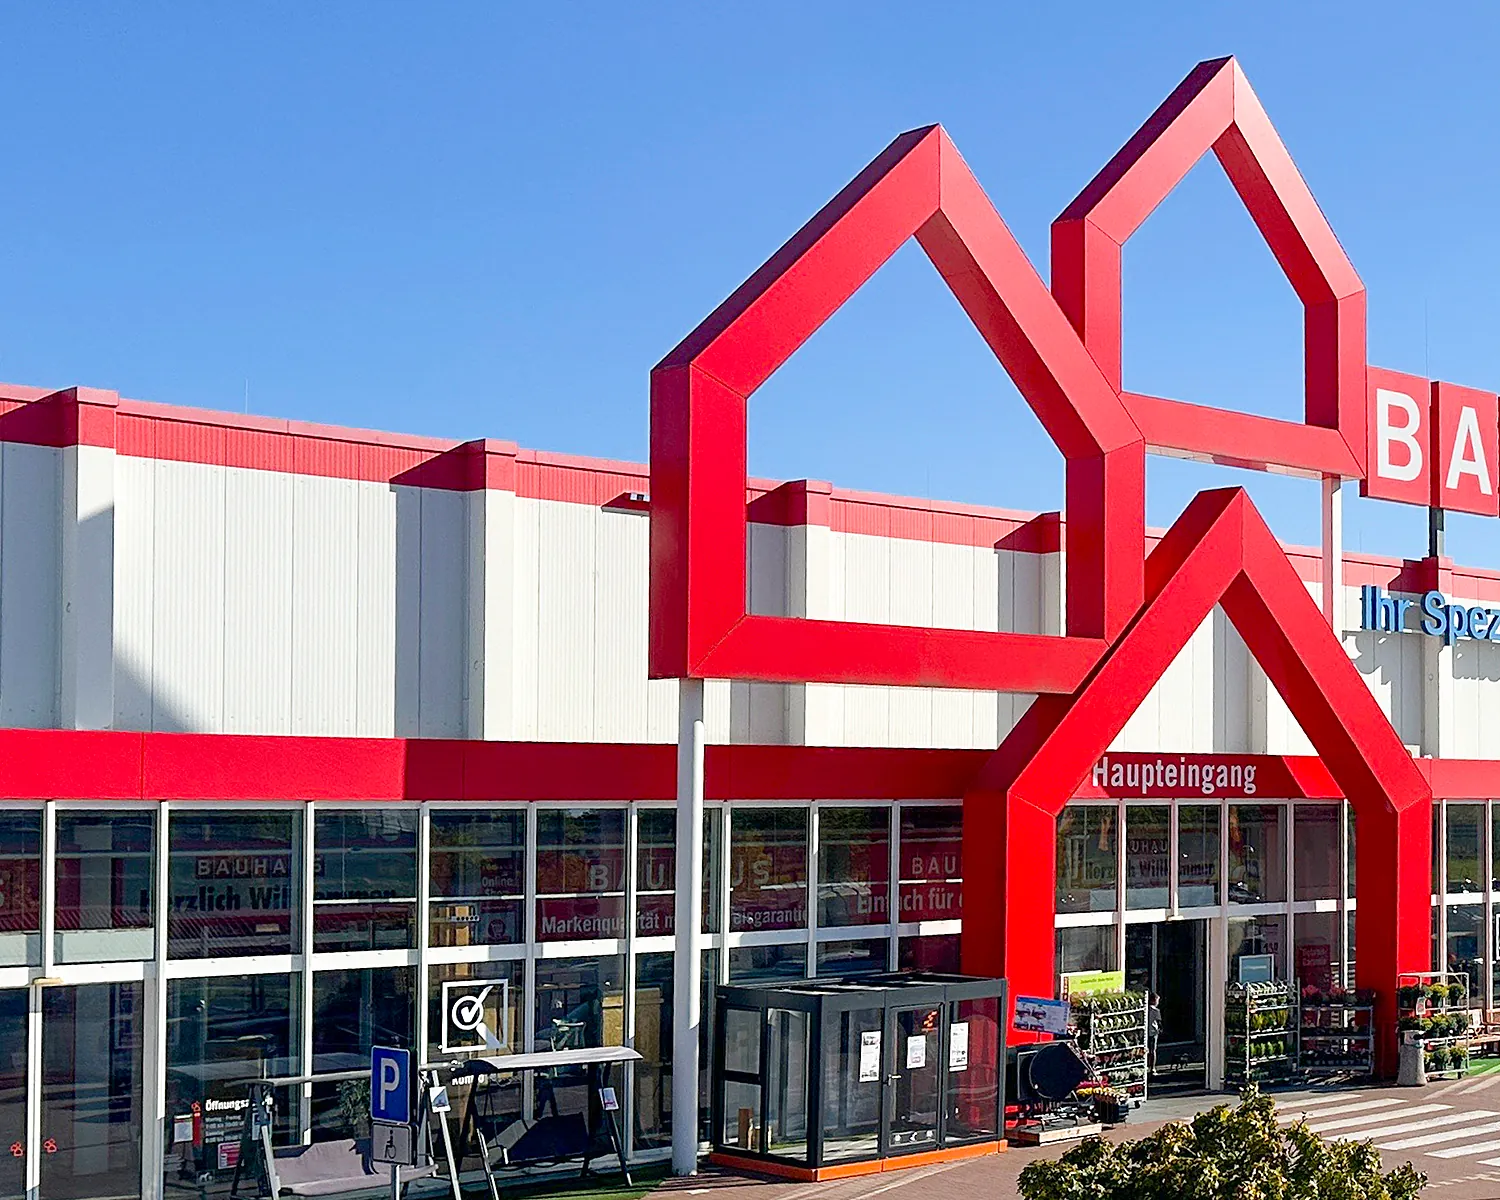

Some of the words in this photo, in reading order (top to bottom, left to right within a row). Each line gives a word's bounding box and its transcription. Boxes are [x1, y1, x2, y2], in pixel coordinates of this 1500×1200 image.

[1362, 585, 1410, 632] Ihr
[1093, 757, 1256, 794] Haupteingang
[929, 888, 955, 911] für
[380, 1057, 400, 1110] P
